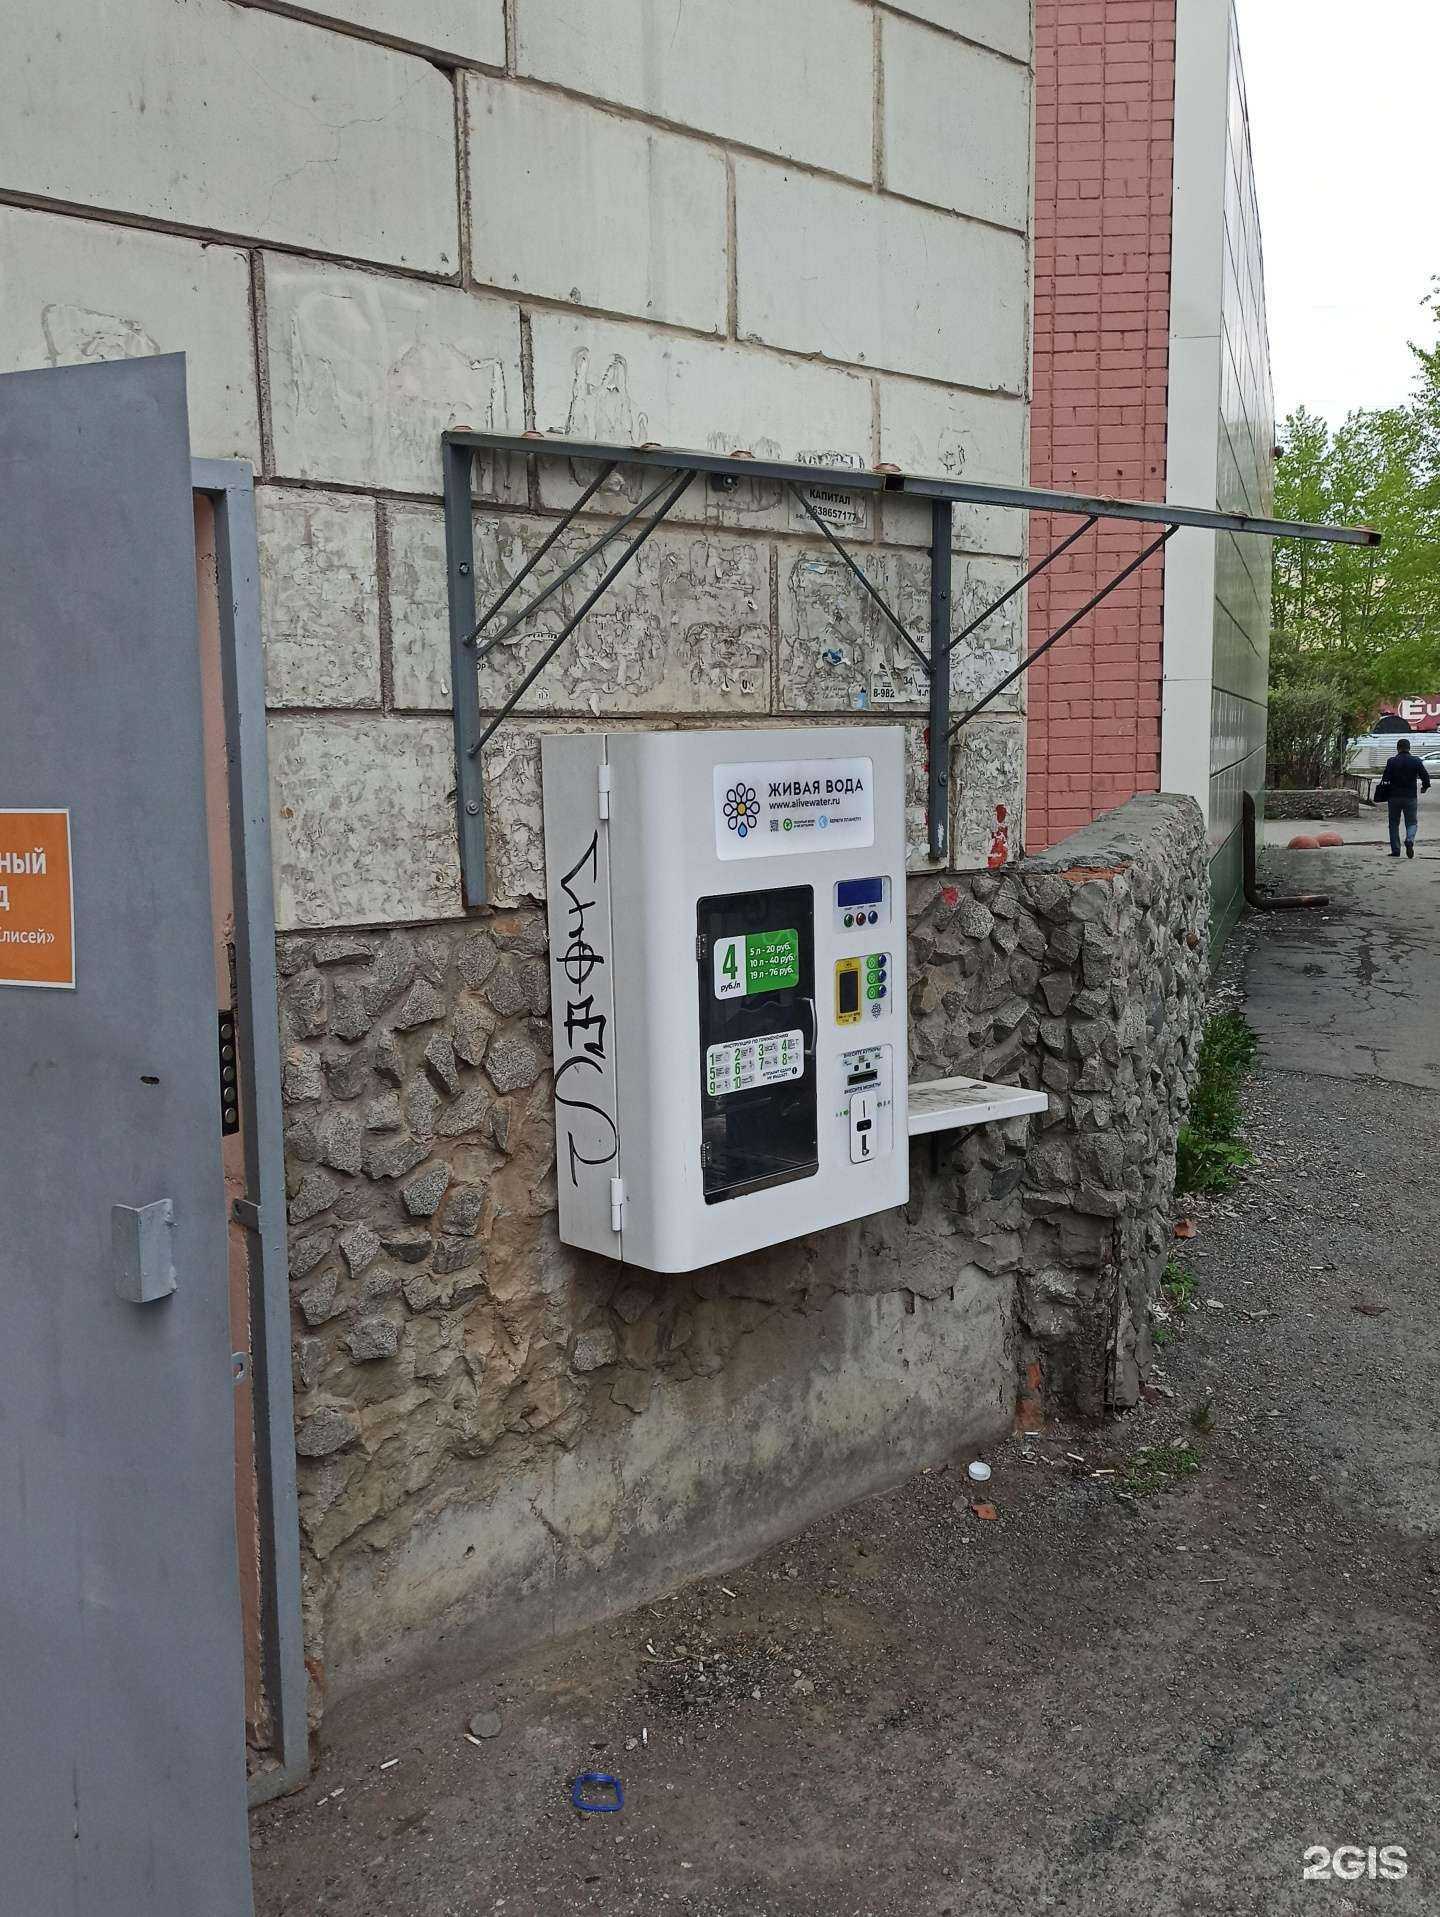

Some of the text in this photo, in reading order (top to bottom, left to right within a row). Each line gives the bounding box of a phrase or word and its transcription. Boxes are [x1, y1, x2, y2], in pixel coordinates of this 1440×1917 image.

[809, 489, 851, 505] КАПИТАЛ
[806, 504, 857, 522] 638657177
[768, 778, 864, 797] ЖИВАЯ ВОДА
[750, 948, 755, 956] 5
[766, 944, 776, 954] 20
[776, 941, 791, 953] руб.
[723, 944, 738, 979] 4
[769, 955, 780, 964] 40
[780, 953, 795, 965] руб.
[750, 971, 758, 980] 19
[769, 968, 779, 976] 76
[779, 965, 794, 977] руб.
[758, 1043, 764, 1057] 3
[781, 1038, 788, 1052] 4
[710, 1054, 714, 1066] 1
[734, 1048, 741, 1062] 2
[782, 1053, 787, 1065] 8
[735, 1062, 741, 1076] 6
[759, 1058, 764, 1070] 7
[709, 1066, 716, 1081] 5
[709, 1081, 716, 1095] 9
